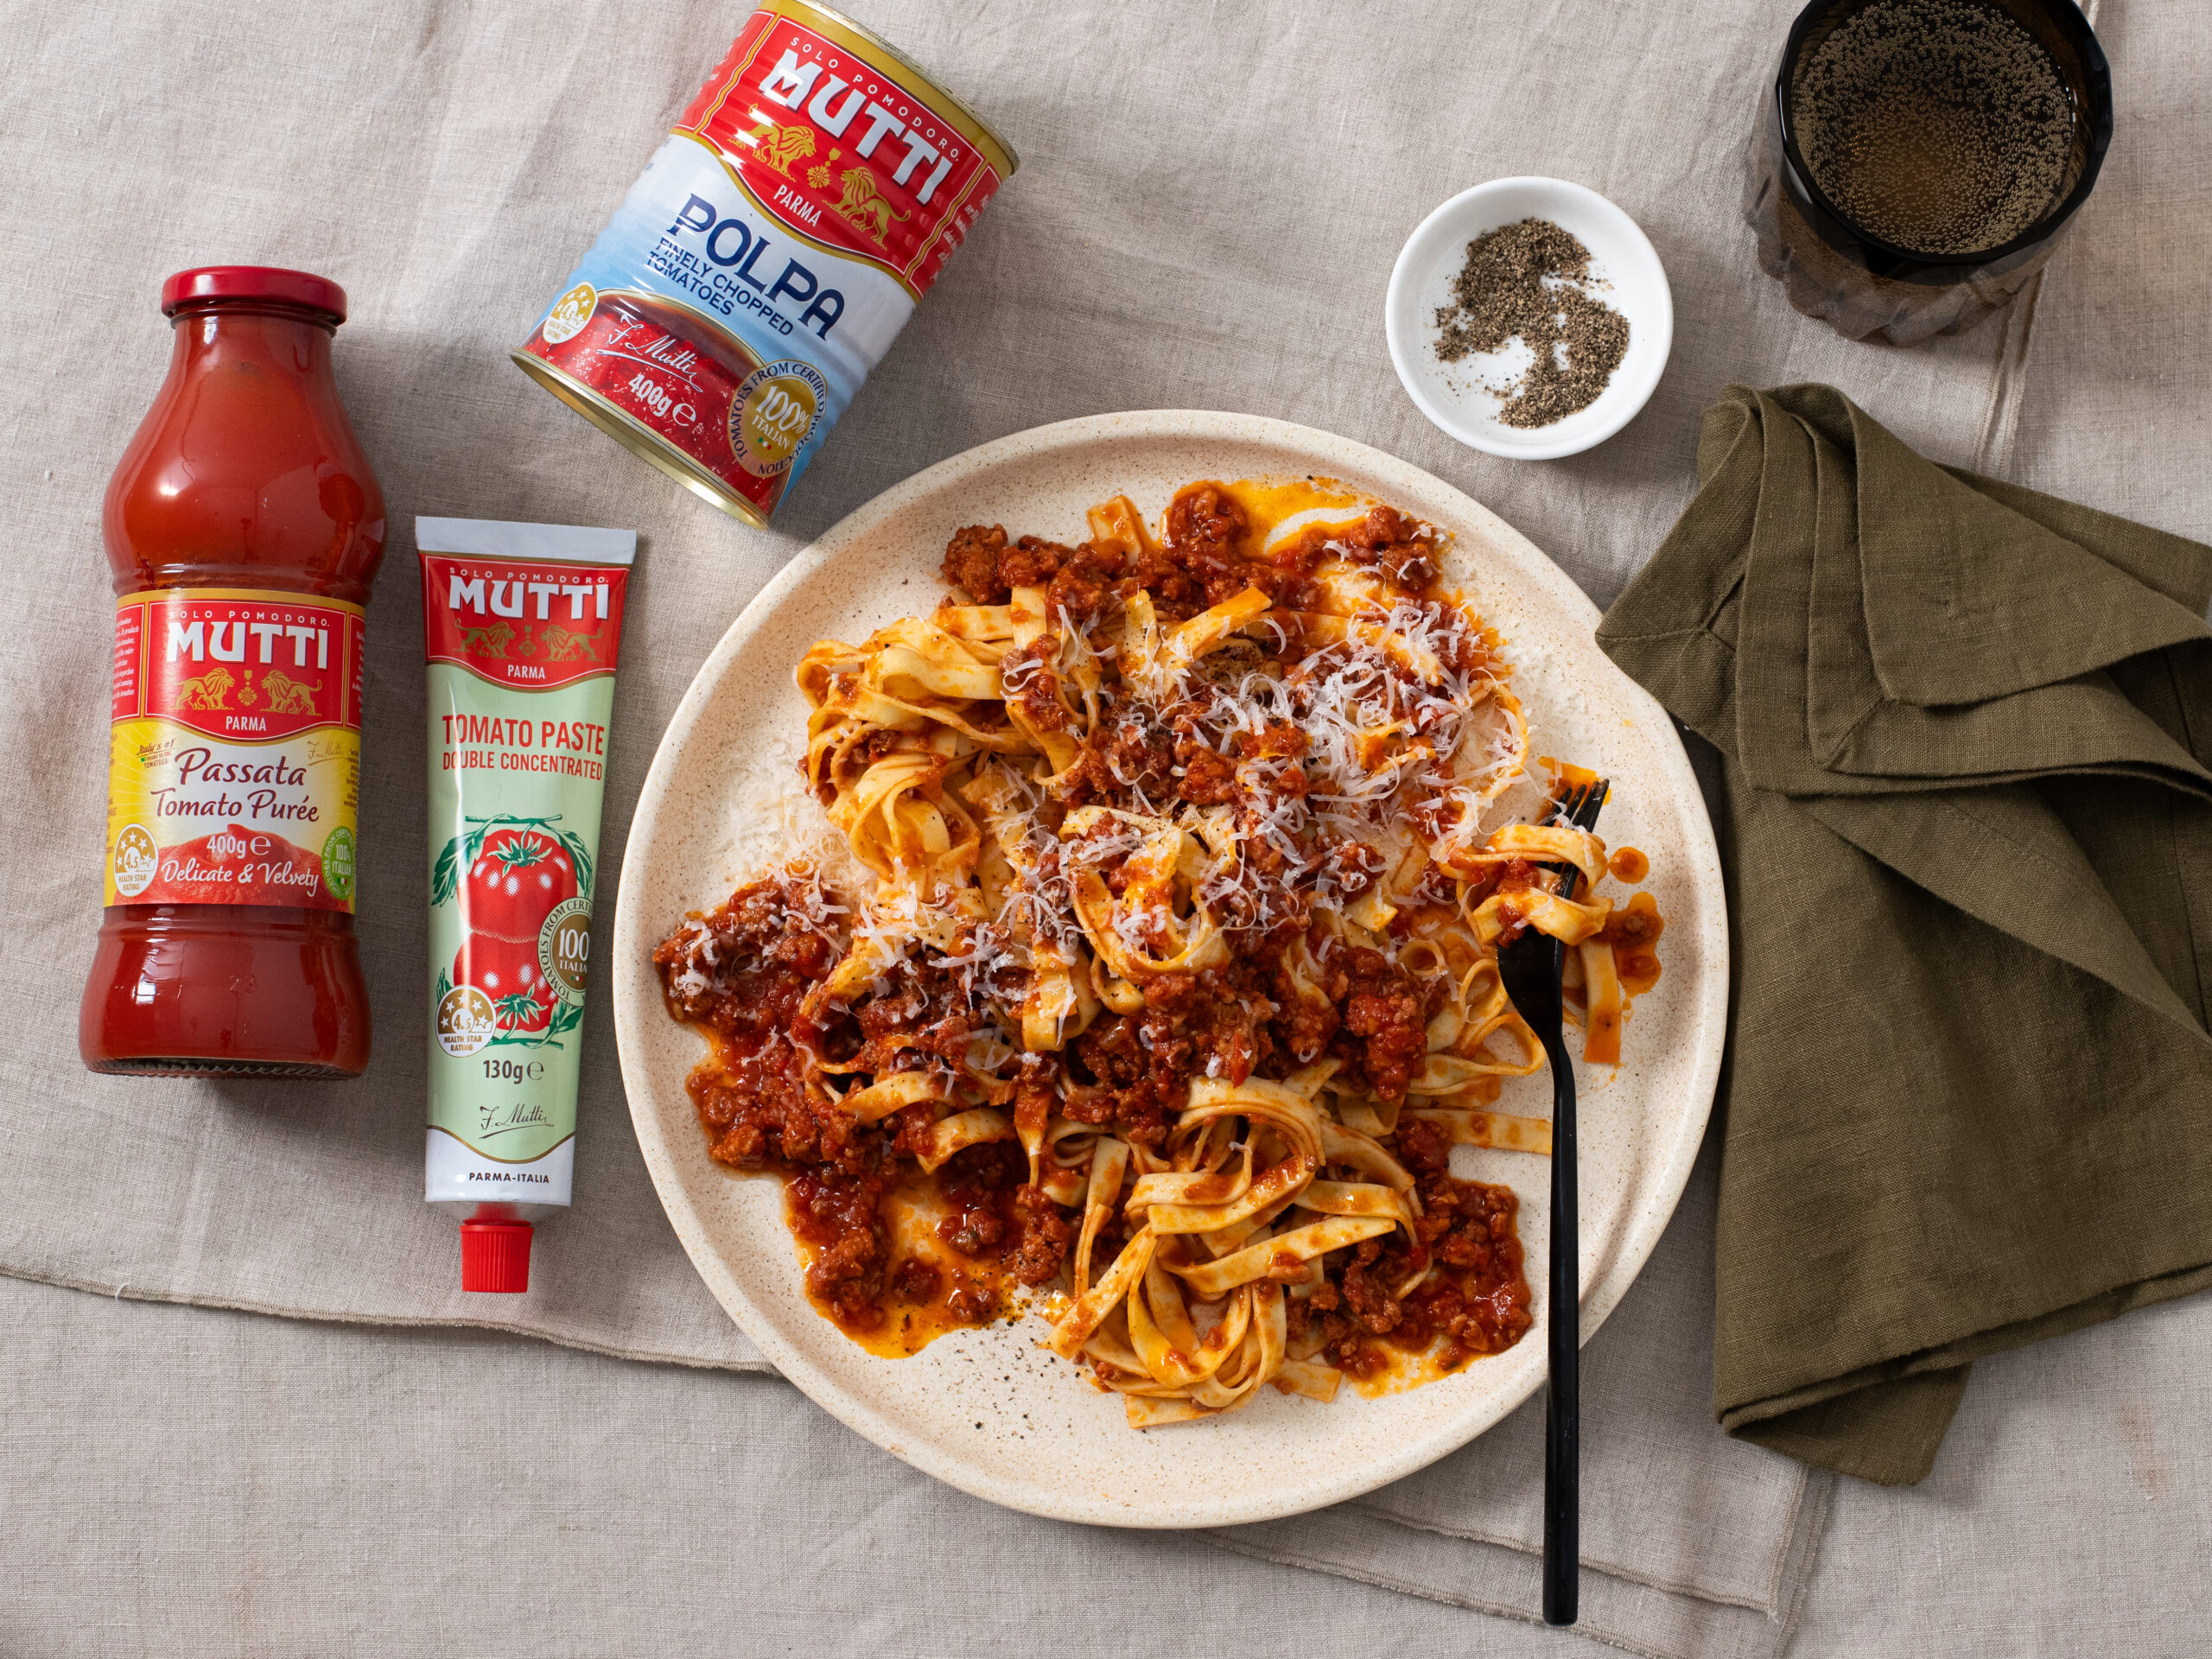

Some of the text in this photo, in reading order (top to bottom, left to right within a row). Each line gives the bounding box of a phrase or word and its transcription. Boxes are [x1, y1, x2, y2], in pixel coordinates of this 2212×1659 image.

[790, 36, 838, 69] SOLO
[757, 48, 953, 207] MUTTI
[772, 184, 823, 228] PARMA
[646, 251, 736, 316] TOMATOES
[665, 193, 845, 341] POLPA
[655, 237, 794, 336] FINELY CHOPPED
[628, 372, 673, 417] 400g
[730, 384, 753, 461] TOMATOES
[751, 362, 789, 386] FROM
[791, 363, 825, 412] CERTIFIED
[756, 385, 810, 434] 100%
[752, 415, 791, 450] ITALIAN
[449, 567, 493, 579] SOLO
[169, 610, 213, 620] SOLO
[448, 575, 609, 620] MUTTI
[166, 620, 329, 670] MUTTI
[507, 664, 546, 680] PARMA
[226, 715, 267, 732] PARMA
[442, 714, 605, 756] TOMATO PASTE
[174, 747, 307, 786] Passata
[442, 751, 602, 781] DOUBLE CONCENTRATED
[149, 787, 320, 823] Tomato Purée
[125, 852, 139, 869] 4.5
[206, 835, 247, 859] 400g
[162, 857, 232, 885] Delicate
[238, 862, 253, 884] &
[257, 861, 320, 898] Velvety
[542, 905, 566, 938] FROM
[539, 939, 569, 1001] TOMATOES
[454, 1014, 471, 1030] 4.5
[483, 1059, 524, 1084] 130g
[468, 1172, 550, 1184] PARMA-ITALIA
